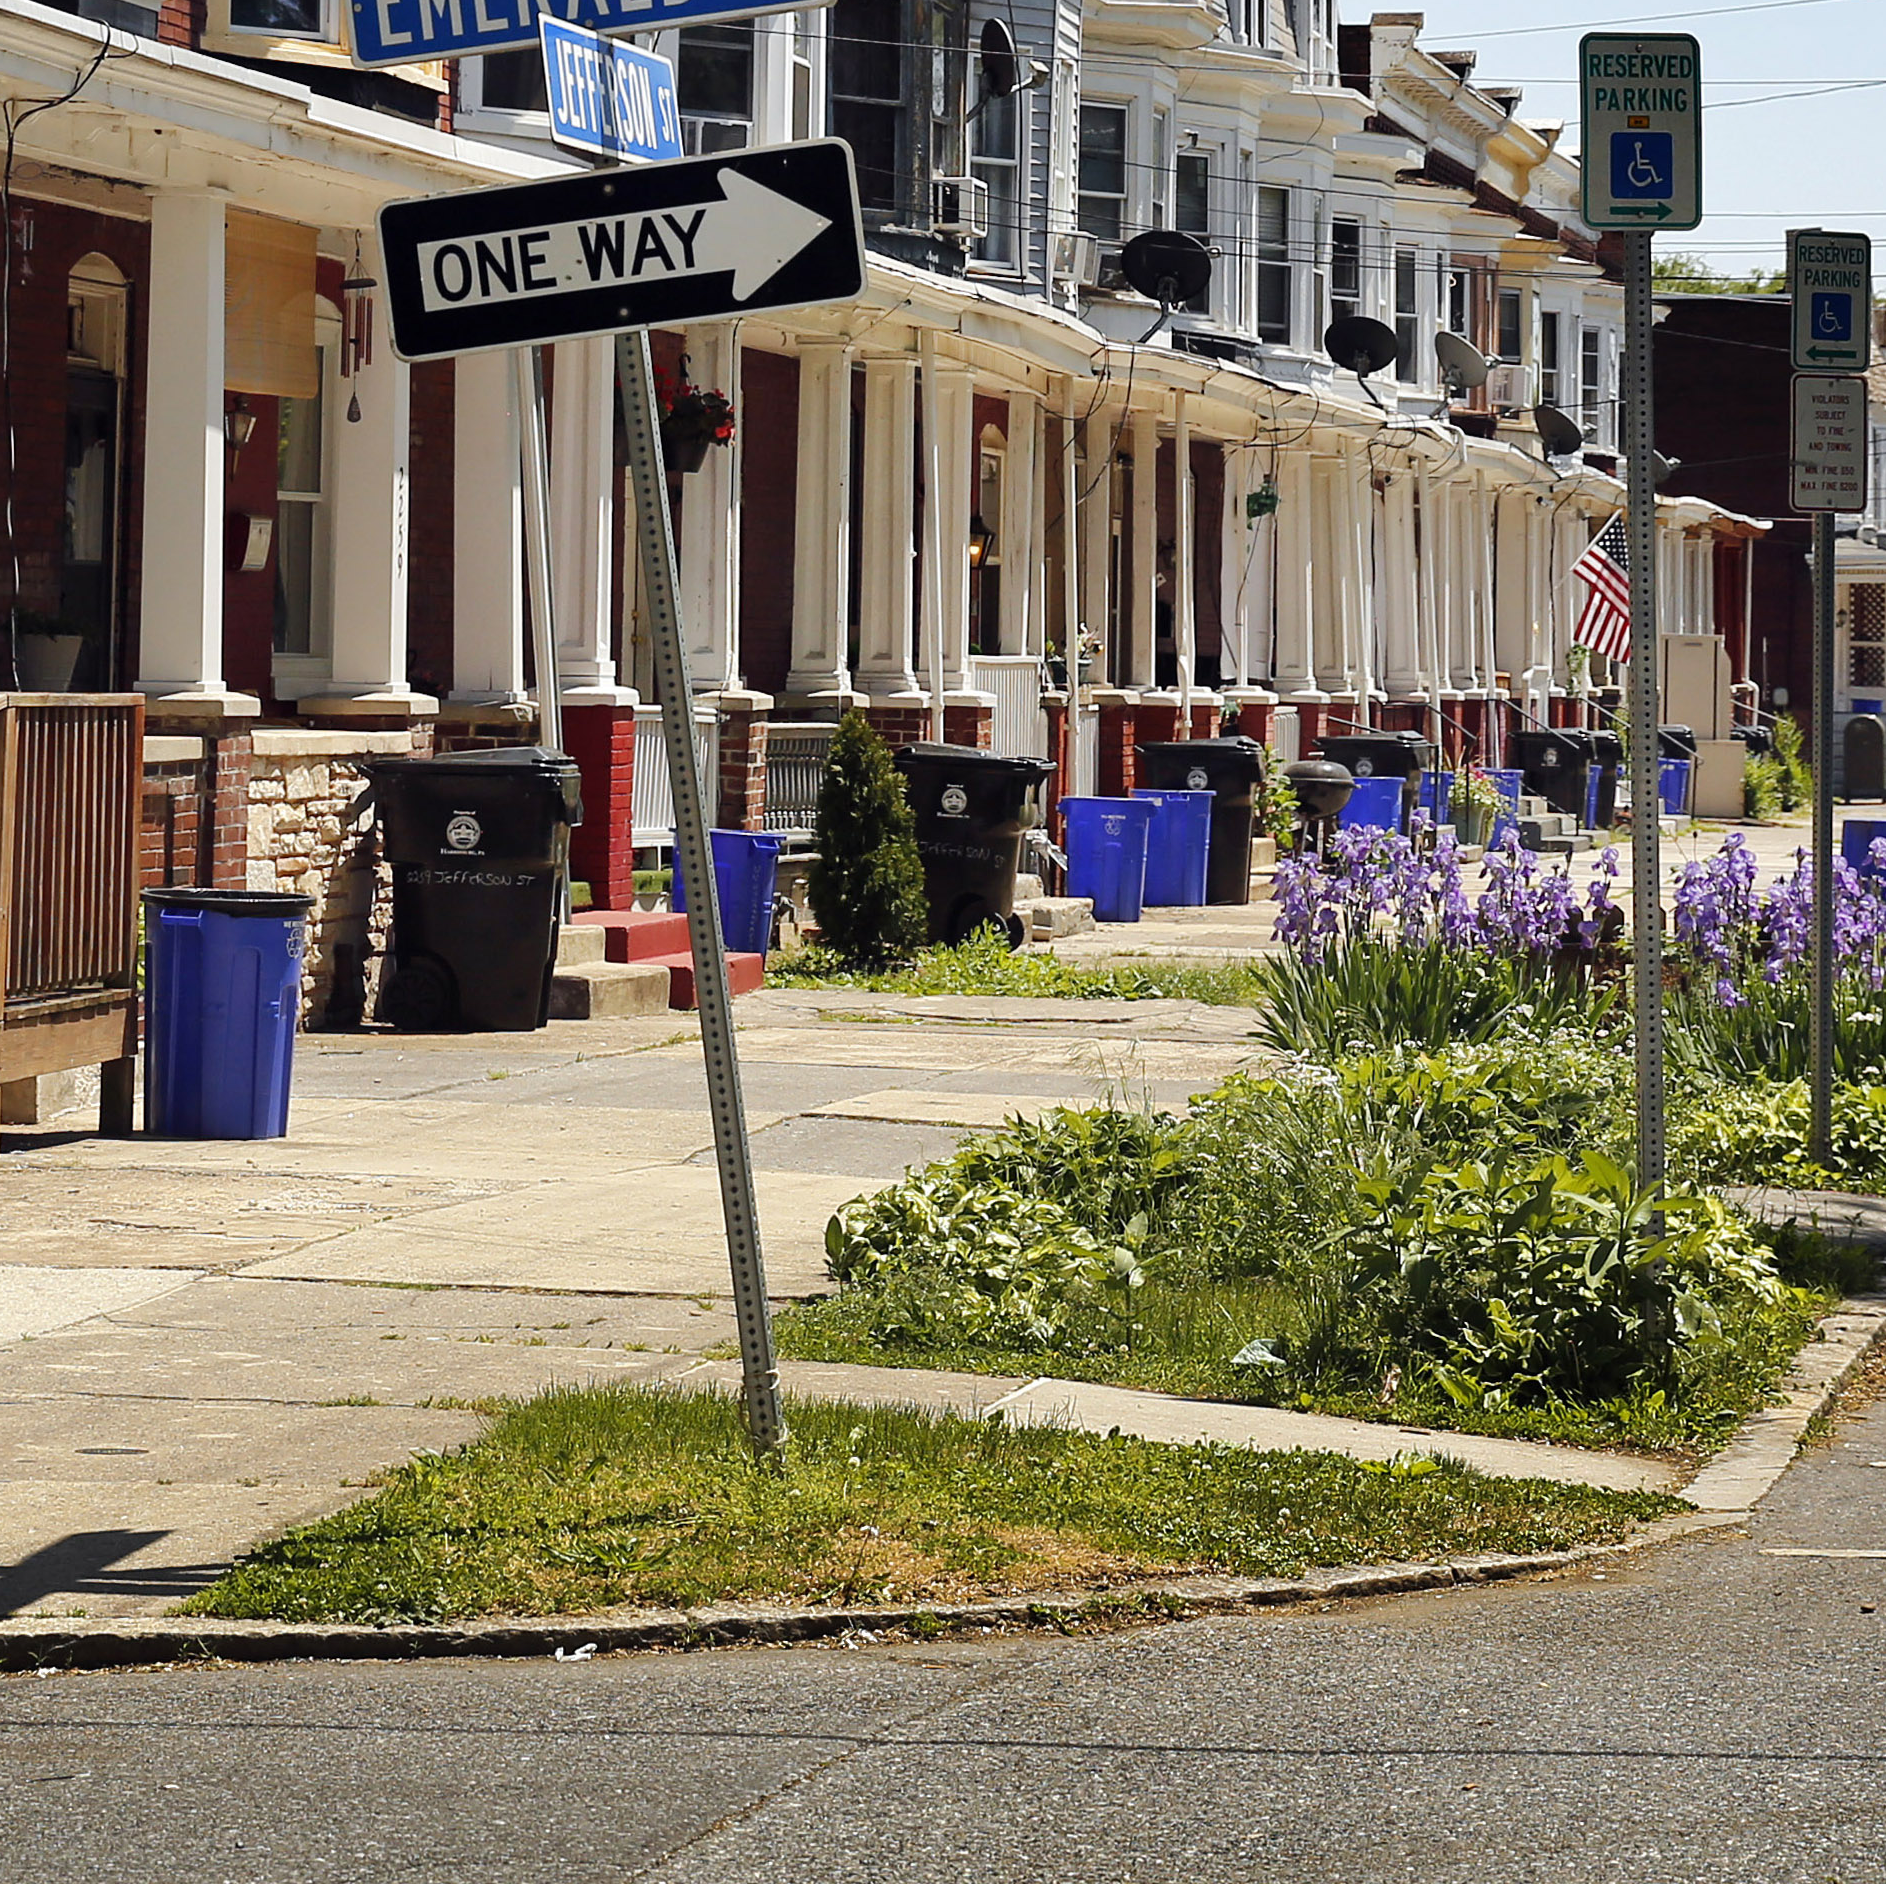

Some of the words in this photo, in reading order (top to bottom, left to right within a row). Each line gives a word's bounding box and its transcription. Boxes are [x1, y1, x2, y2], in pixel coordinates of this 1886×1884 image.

[1589, 54, 1692, 78] RESERVED
[555, 37, 659, 150] JEFFERSON
[657, 87, 676, 146] ST
[1595, 88, 1688, 112] PARKING
[433, 231, 557, 302] ONE
[577, 209, 707, 281] WAY
[1799, 245, 1865, 265] RESERVED
[1804, 269, 1861, 289] PARKING
[1811, 395, 1850, 405] VIOLATORS
[1815, 410, 1846, 420] SUBJECT
[1817, 426, 1826, 435] TO
[1829, 426, 1844, 436] FINE
[1809, 442, 1823, 451] AND
[1827, 442, 1852, 452] TOWING
[1823, 466, 1837, 476] FINE
[1822, 481, 1837, 492] FINE
[516, 874, 536, 886] ST
